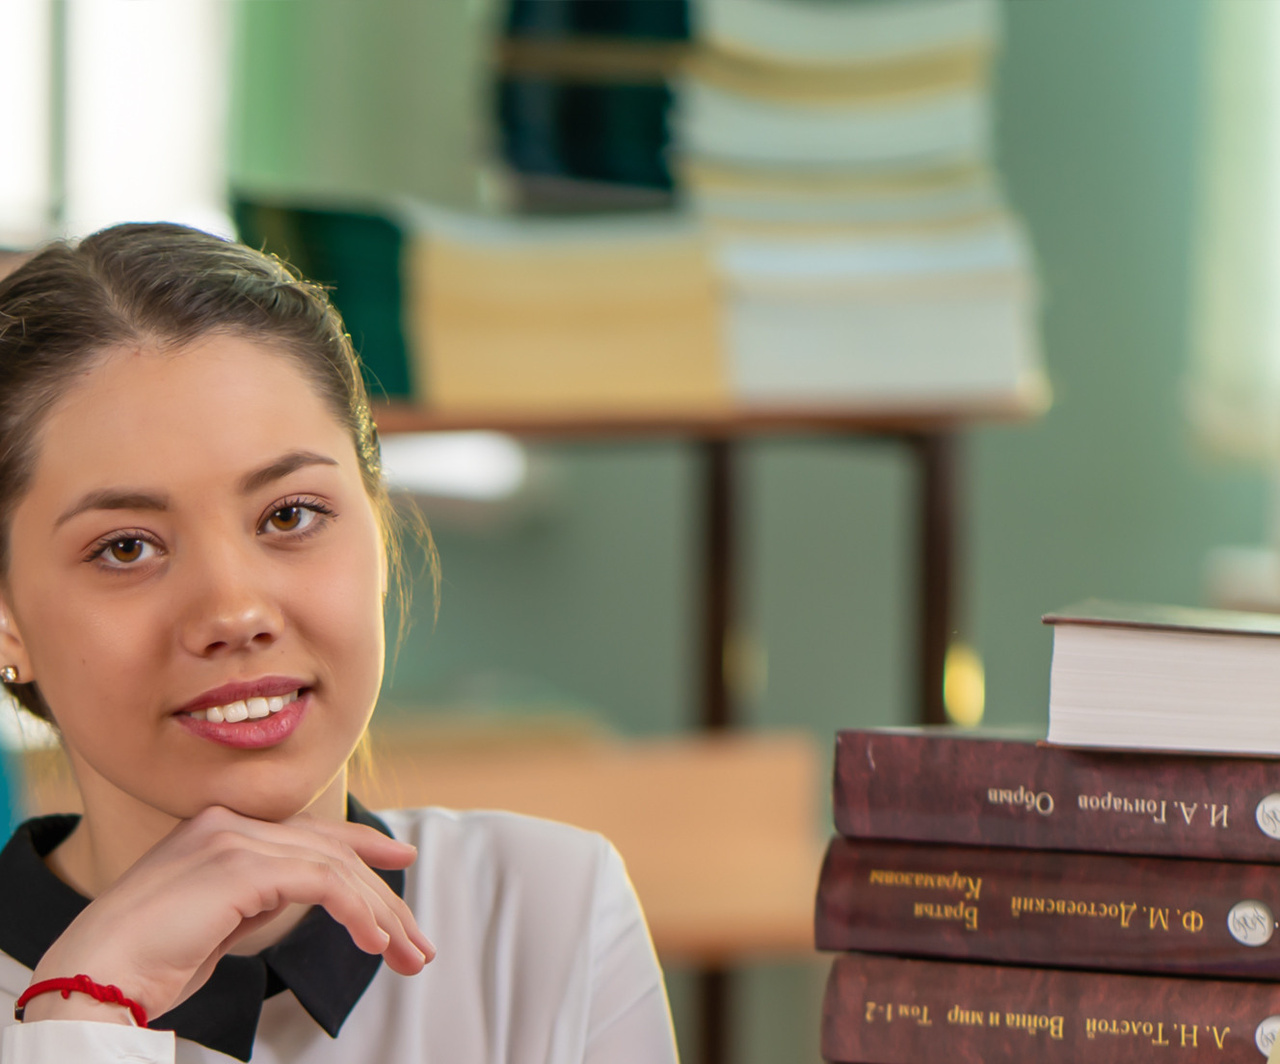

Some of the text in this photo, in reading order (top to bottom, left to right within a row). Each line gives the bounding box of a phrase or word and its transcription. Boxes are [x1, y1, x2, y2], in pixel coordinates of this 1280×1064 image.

[987, 785, 1054, 816] Обрыв
[1078, 791, 1167, 824] Гончаров
[1174, 801, 1198, 825] А.
[1204, 803, 1229, 828] И.
[869, 869, 982, 900] Карамазовы
[914, 901, 978, 931] Братья
[1011, 895, 1137, 928] Достоевский
[1142, 905, 1170, 932] М.
[1177, 909, 1204, 933] Ф.
[865, 1001, 893, 1022] 1-2
[898, 1003, 932, 1026] Том
[947, 1004, 984, 1027] мир
[989, 1011, 1000, 1027] и
[1006, 1012, 1065, 1040] Война
[1086, 1017, 1169, 1046] Толстой
[1173, 1023, 1198, 1048] Н.
[1205, 1026, 1231, 1050] Л.
